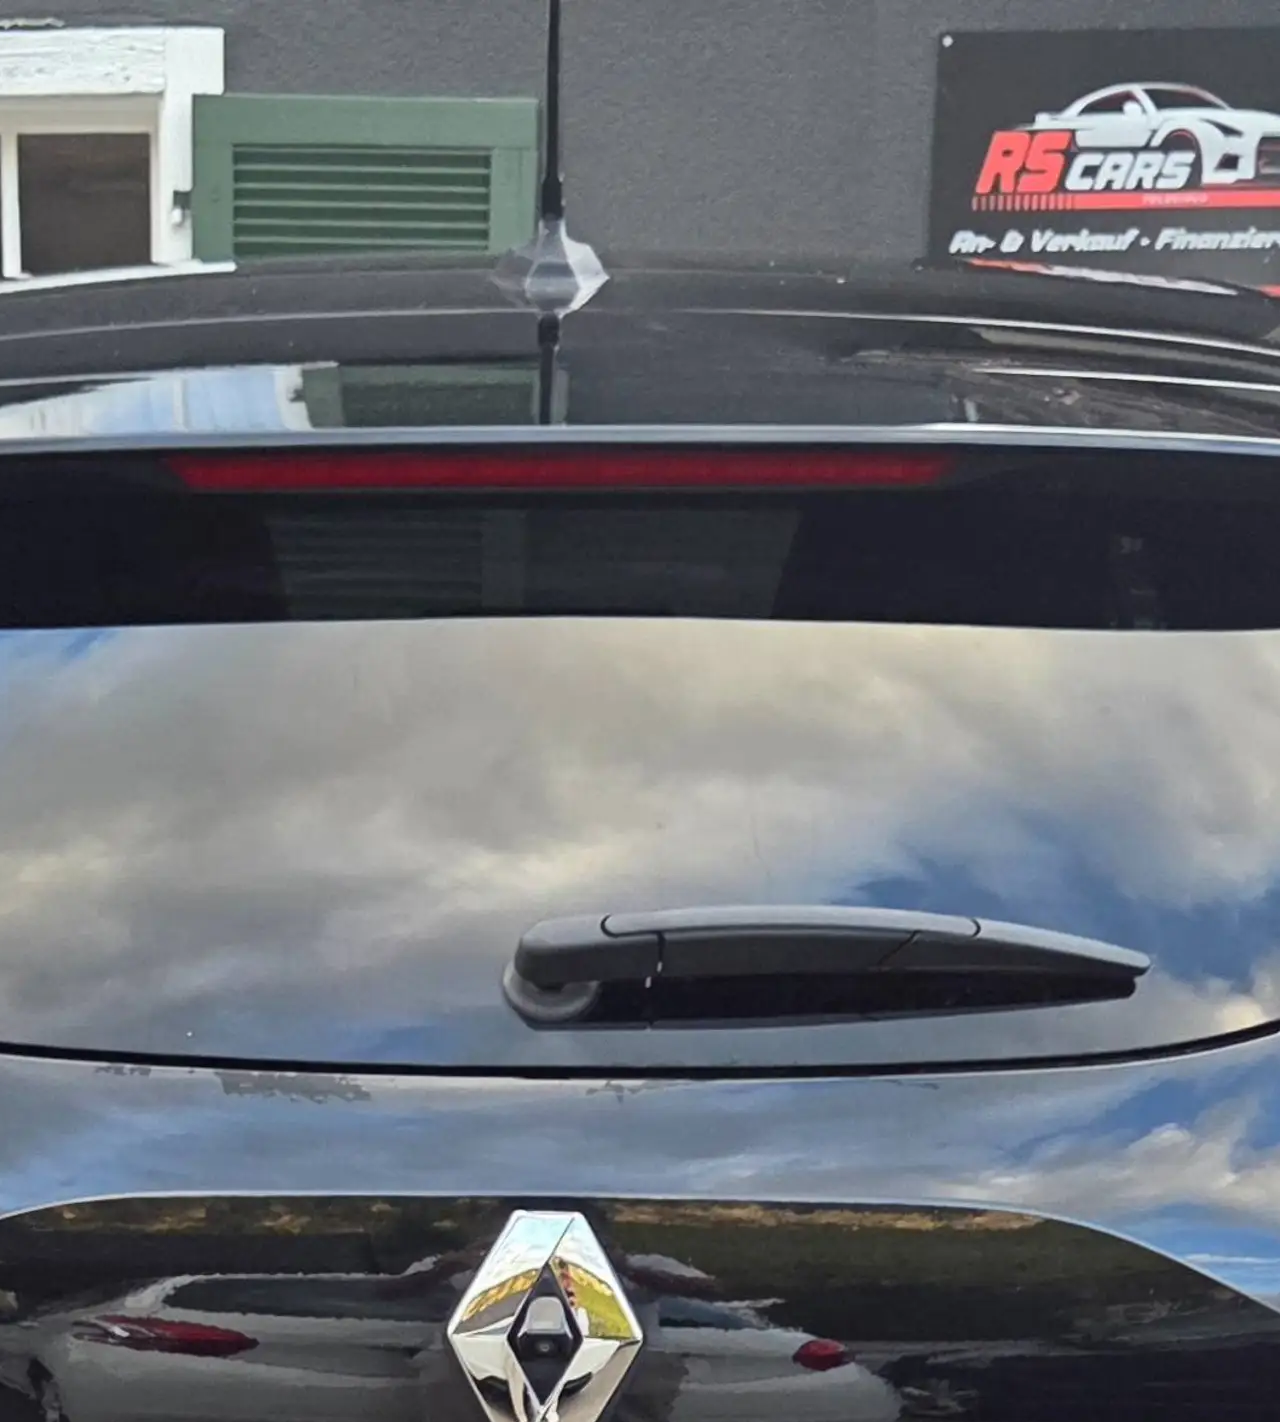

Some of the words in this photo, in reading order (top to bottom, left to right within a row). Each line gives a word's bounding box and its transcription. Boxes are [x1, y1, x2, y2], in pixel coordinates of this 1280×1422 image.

[975, 130, 1072, 194] RS
[1064, 151, 1196, 191] CARS
[1030, 228, 1140, 252] Verkauf
